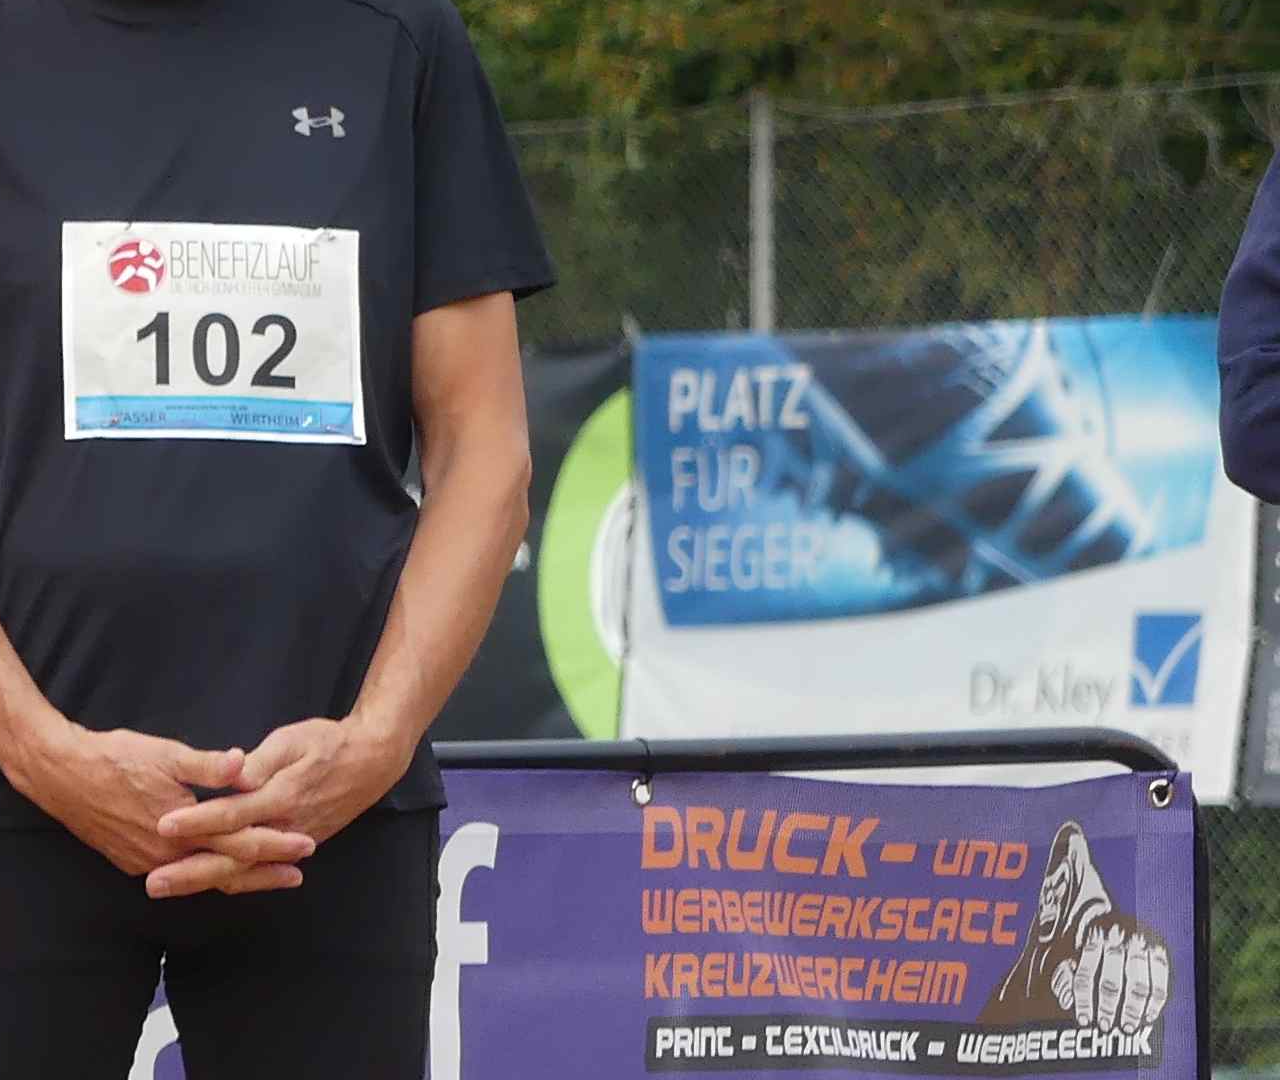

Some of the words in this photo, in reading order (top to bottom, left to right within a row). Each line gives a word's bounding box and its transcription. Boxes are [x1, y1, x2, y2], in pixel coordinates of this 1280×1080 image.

[169, 239, 320, 282] BENEFIZLAUF
[136, 311, 298, 389] 102
[668, 362, 812, 433] PLATZ
[670, 435, 762, 513] FÜR
[666, 522, 824, 592] SIEGER
[969, 662, 1017, 715] Dr.
[1033, 659, 1115, 722] Kley
[641, 888, 1021, 946] WERBEWERKSTATT
[644, 951, 968, 1005] KREUZWERTHEIM
[655, 1026, 734, 1058] PRINT
[765, 1025, 920, 1061] TEXTILDRUCK
[956, 1024, 1153, 1064] WERBETECHNIK
